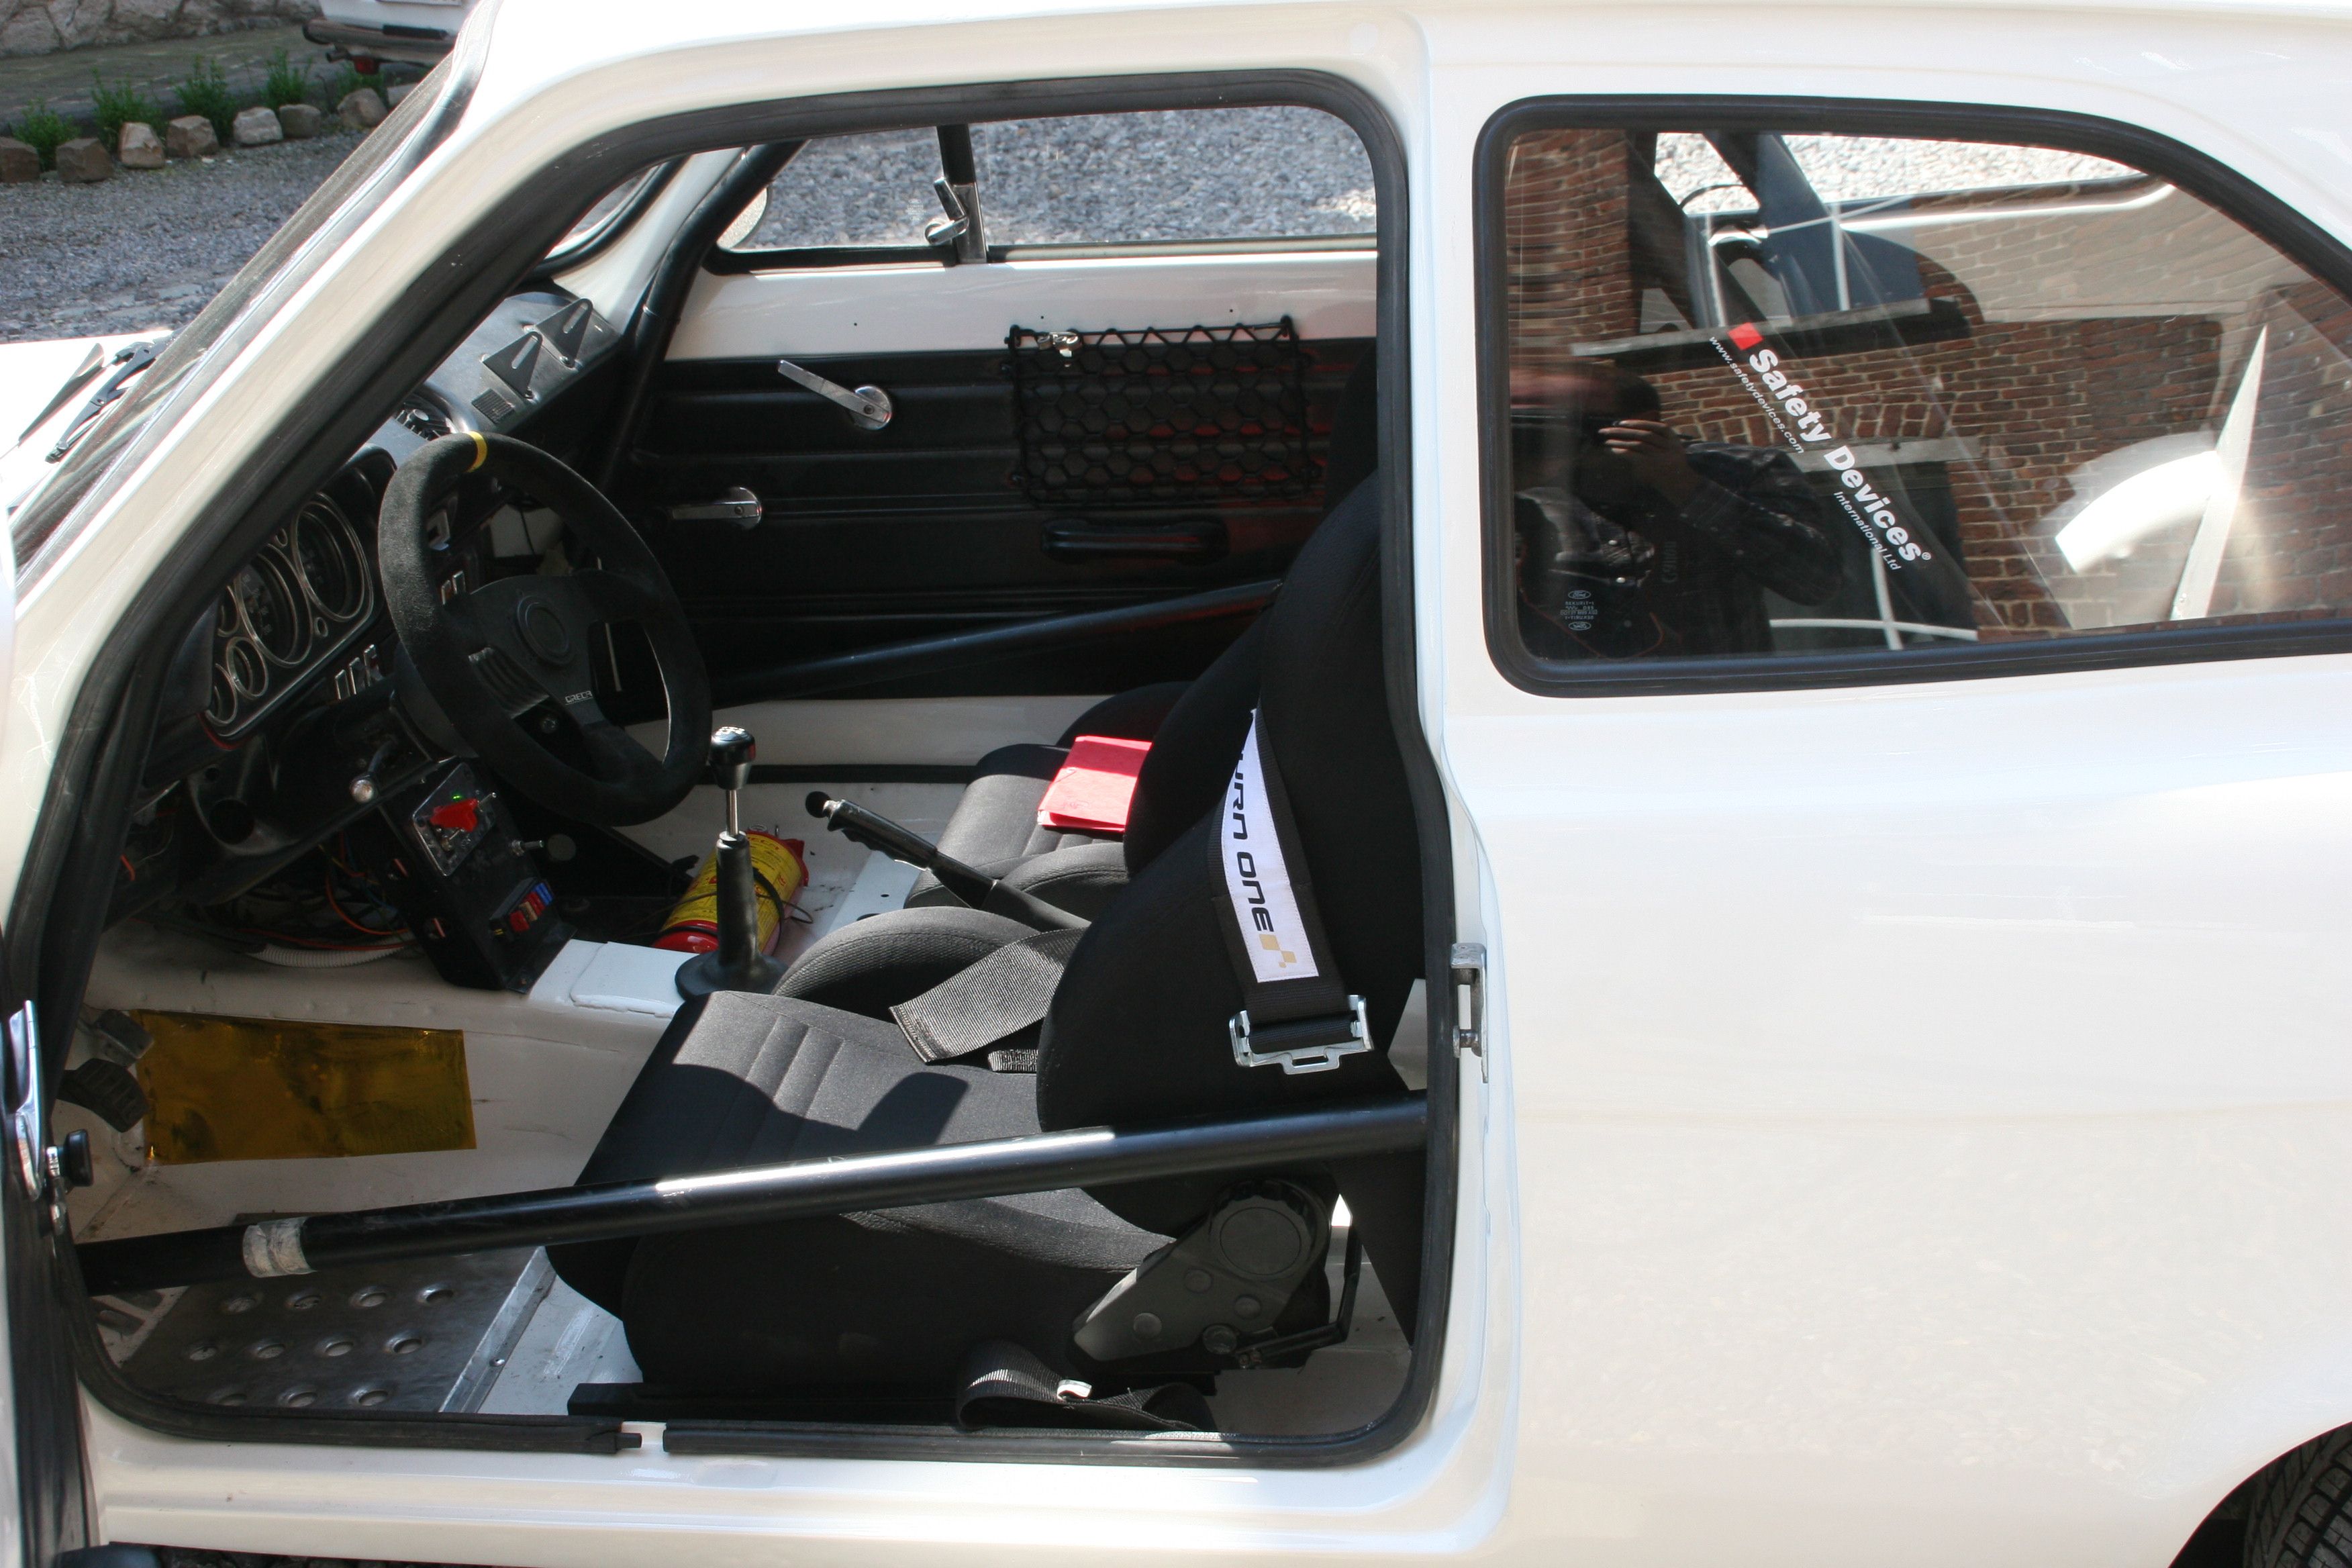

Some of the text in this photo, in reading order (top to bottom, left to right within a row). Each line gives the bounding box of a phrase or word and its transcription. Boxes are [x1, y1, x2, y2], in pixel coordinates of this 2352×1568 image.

[1709, 336, 1804, 454] www.safetydevices.com
[1749, 349, 1832, 442] Safety
[1834, 491, 1901, 571] International Ltd
[1236, 852, 1275, 932] ONE
